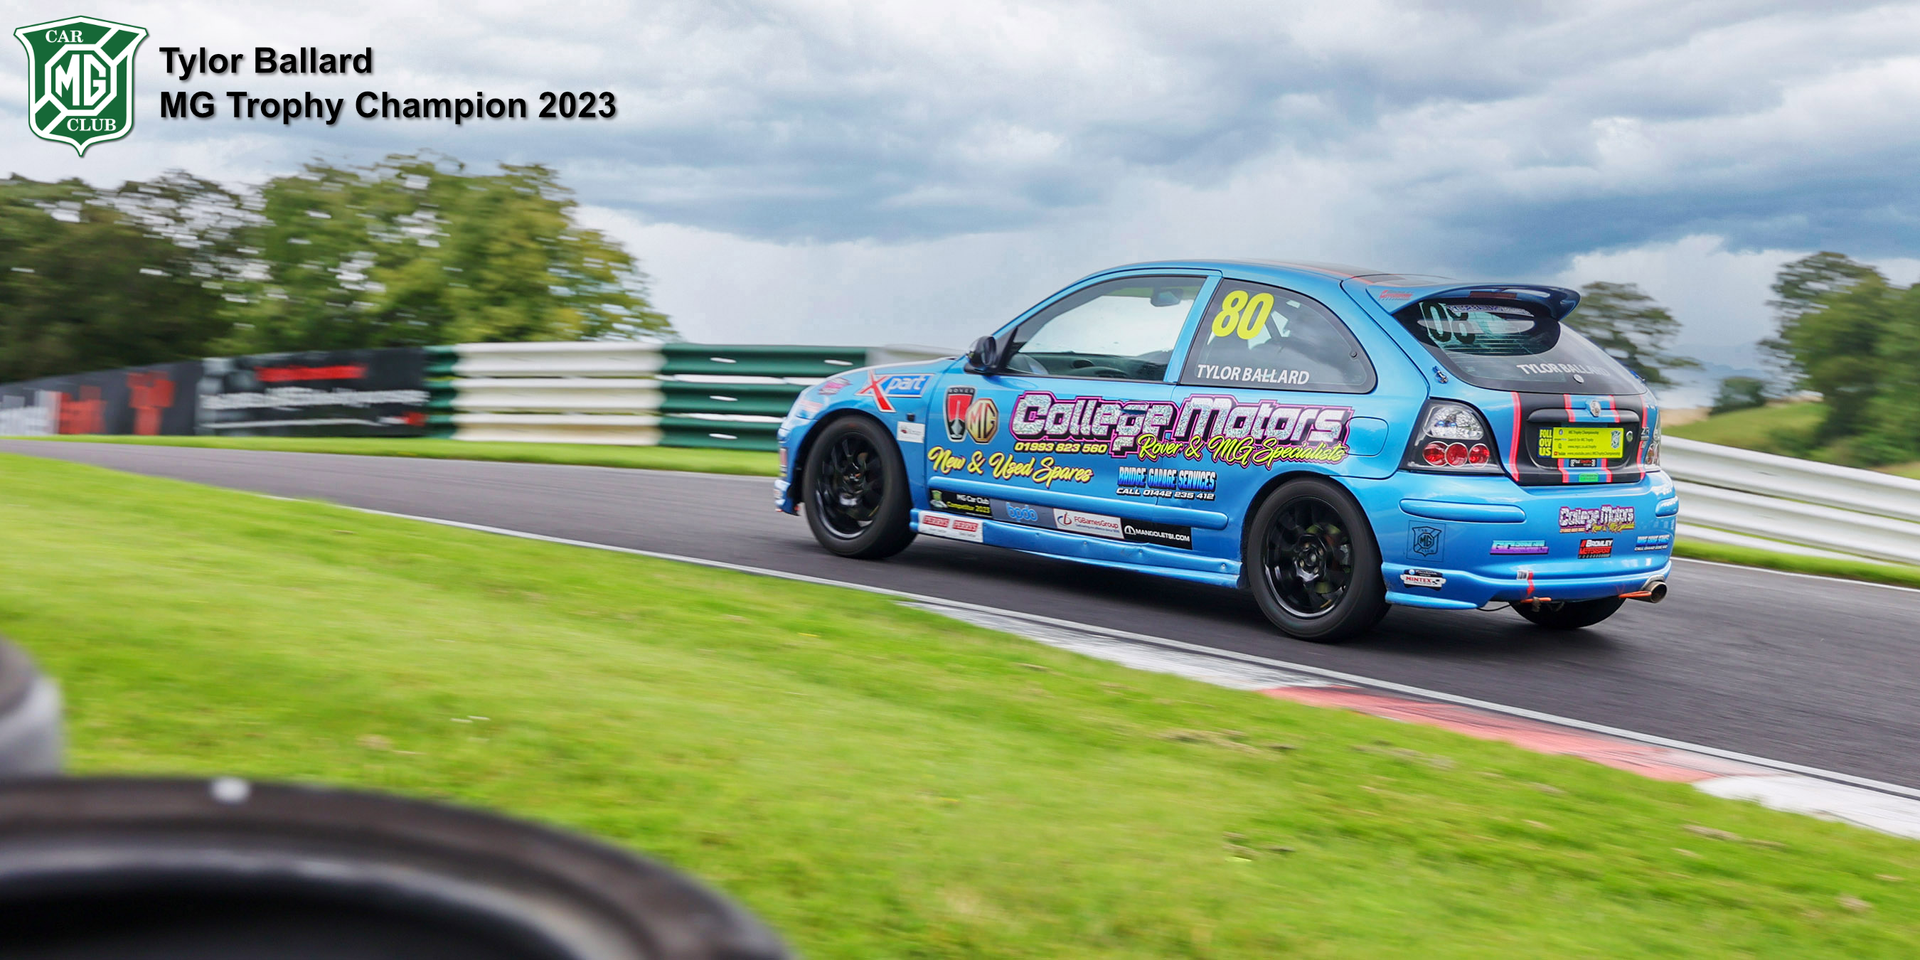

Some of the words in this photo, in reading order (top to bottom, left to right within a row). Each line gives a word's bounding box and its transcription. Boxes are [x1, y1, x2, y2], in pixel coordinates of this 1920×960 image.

[1212, 290, 1274, 340] 80
[1197, 364, 1241, 380] TYLOR
[1242, 368, 1310, 385] BALLARD
[1517, 363, 1562, 375] TYLOR
[1562, 363, 1610, 377] BALLARD
[968, 401, 997, 439] MG
[1011, 393, 1174, 452] College
[1175, 396, 1351, 443] Motors
[1014, 442, 1055, 452] 01993
[1056, 443, 1080, 453] 823
[1083, 444, 1107, 454] 560
[1137, 434, 1182, 460] Rover
[1183, 435, 1203, 458] &
[1208, 435, 1253, 464] MG
[1253, 438, 1347, 468] Specialists
[1538, 447, 1551, 456] US
[927, 446, 966, 475] New
[967, 451, 986, 474] &
[988, 452, 1036, 480] Used
[1032, 456, 1094, 488] Spares
[1118, 466, 1147, 487] BRIDGE
[1148, 468, 1177, 489] GARAGE
[1178, 470, 1216, 491] SERVICES
[976, 497, 990, 505] Club
[1116, 488, 1141, 496] CALL
[1143, 489, 1172, 498] 01442
[1174, 491, 1194, 499] 235
[946, 501, 975, 512] Competitor
[1601, 505, 1634, 523] Motors
[1136, 529, 1190, 542] MANGOLETSI.COM
[1419, 534, 1432, 547] MG
